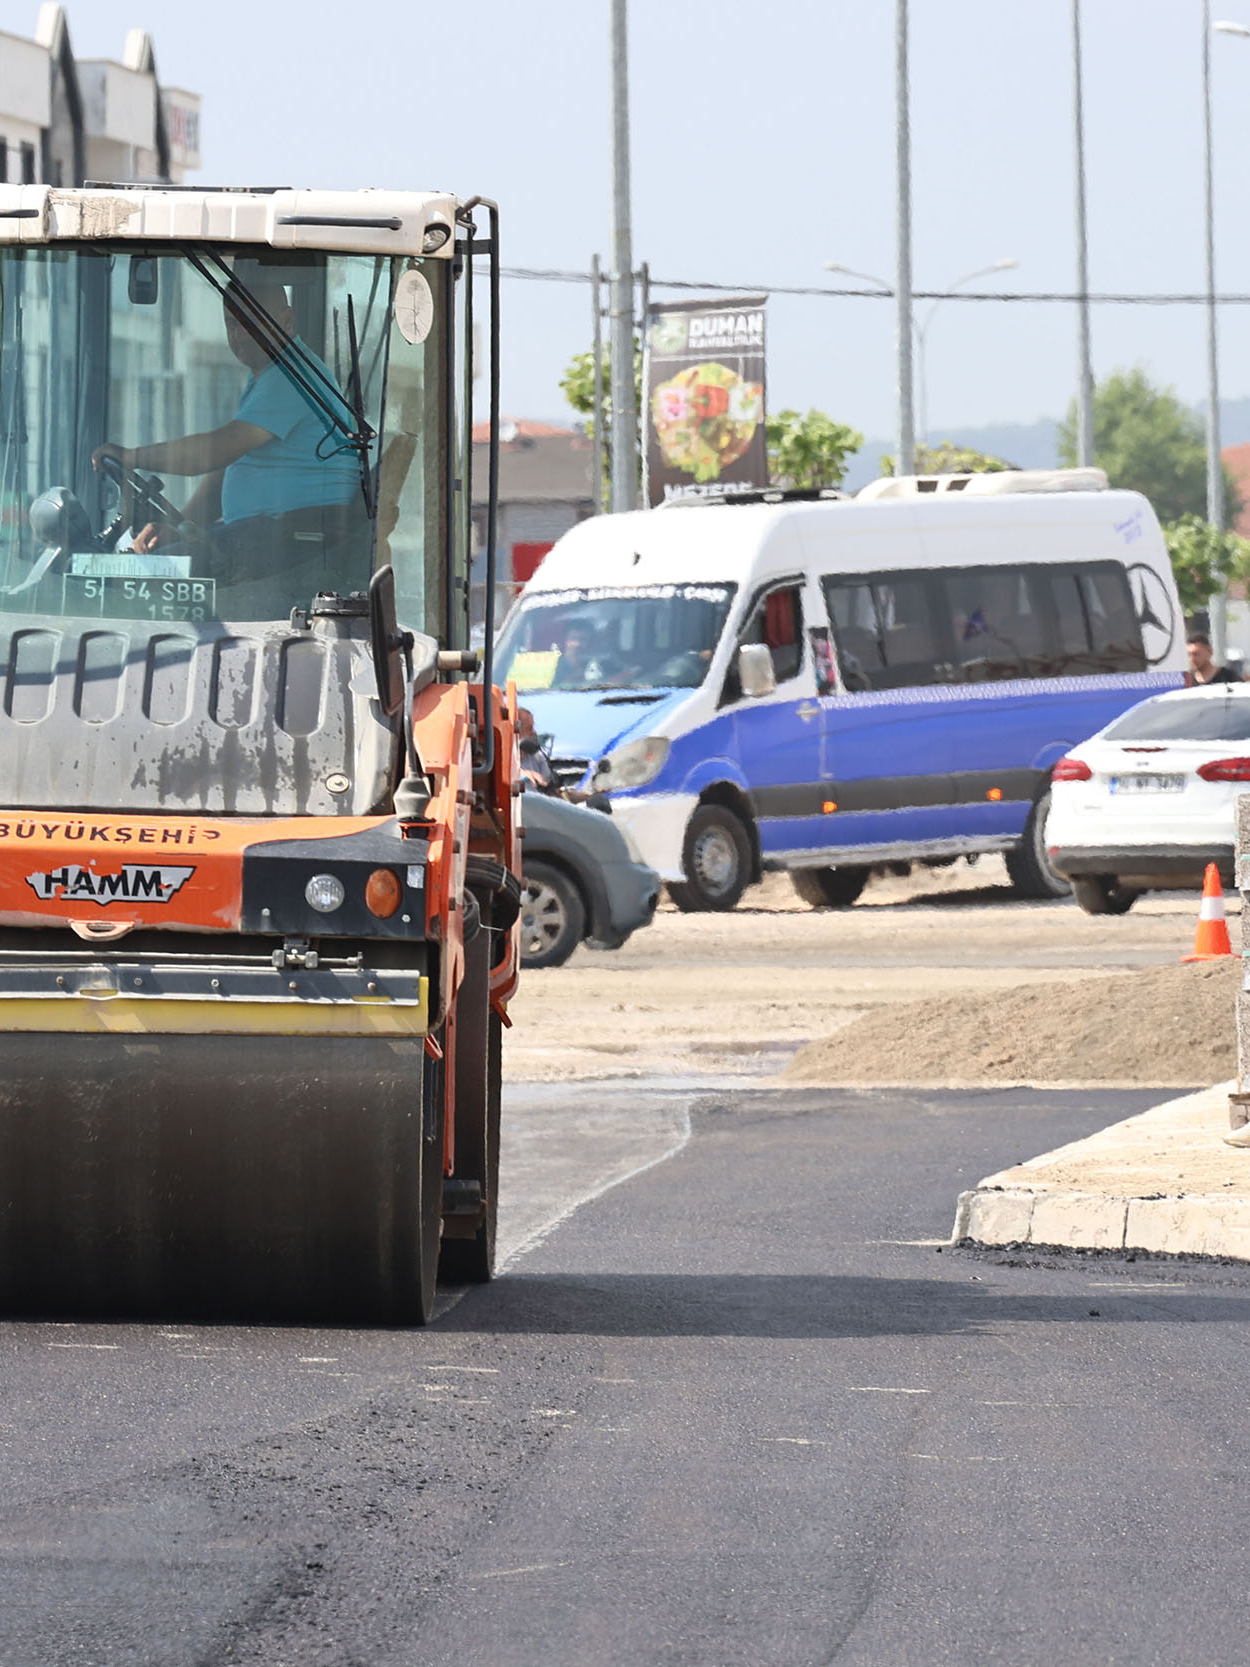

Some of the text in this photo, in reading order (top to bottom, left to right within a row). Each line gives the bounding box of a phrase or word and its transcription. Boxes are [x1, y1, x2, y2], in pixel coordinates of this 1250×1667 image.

[689, 313, 763, 337] DUMAN
[84, 580, 103, 598] 5
[123, 581, 206, 602] 54 SBB
[45, 867, 165, 898] HAMM
